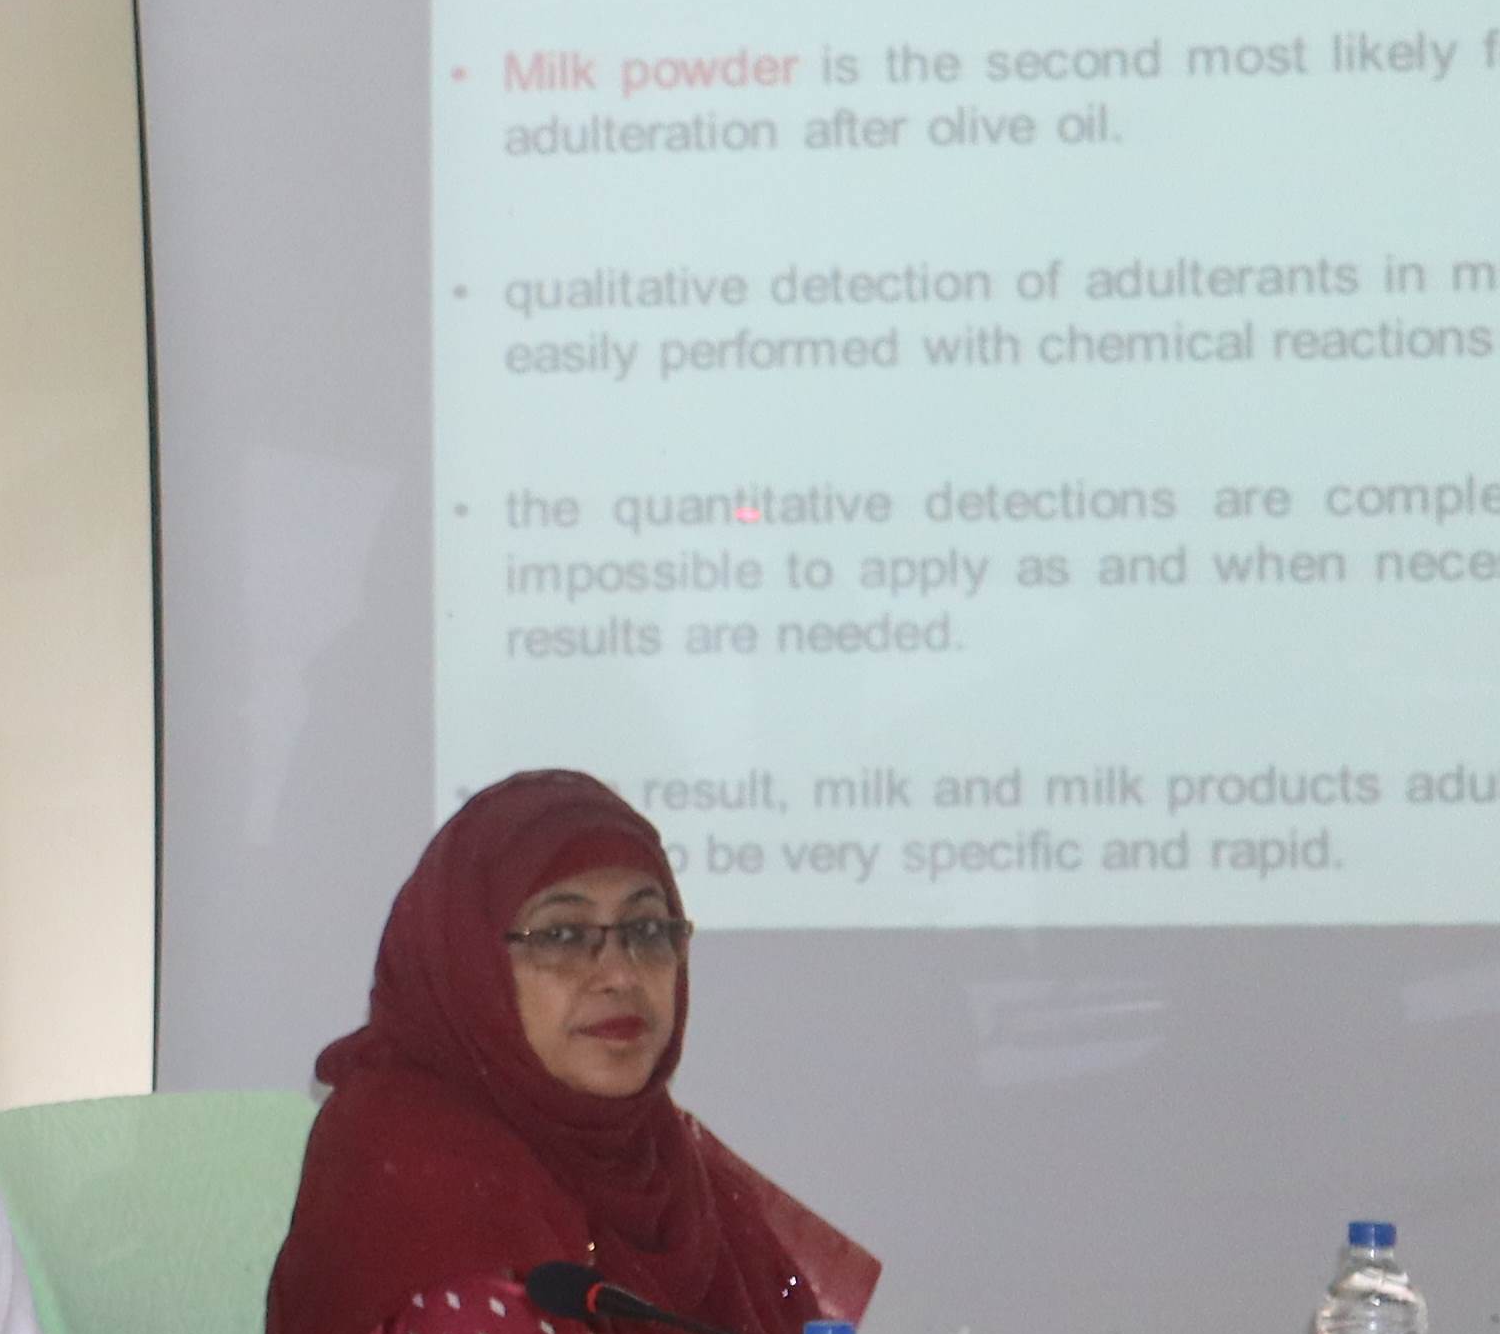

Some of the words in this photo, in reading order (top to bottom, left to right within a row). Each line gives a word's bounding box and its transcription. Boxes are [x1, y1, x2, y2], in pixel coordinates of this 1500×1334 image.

[505, 51, 595, 91] Milk
[622, 50, 799, 96] powder
[822, 45, 860, 87] is
[885, 44, 962, 85] the
[986, 38, 1162, 82] second
[1187, 38, 1308, 77] most
[1333, 31, 1458, 82] likely
[505, 116, 777, 155] adulteration
[804, 108, 908, 150] after
[927, 106, 1037, 147] olive
[1056, 102, 1121, 145] oil.
[505, 270, 748, 317] qualitative
[770, 265, 991, 305] detection
[1016, 258, 1062, 301] of
[1085, 258, 1360, 300] adulterants
[1384, 254, 1426, 294] in
[505, 333, 638, 381] easily
[661, 328, 898, 377] performed
[923, 325, 1021, 366] with
[1038, 323, 1254, 365] chemical
[1273, 321, 1494, 361] reactions
[506, 489, 580, 529] the
[613, 487, 893, 533] quantitative
[925, 482, 1177, 523] detections
[1213, 485, 1292, 519] are
[642, 770, 787, 816] result,
[815, 768, 910, 808] milk
[934, 768, 1022, 807] and
[1046, 767, 1143, 806] milk
[1168, 766, 1381, 812] products
